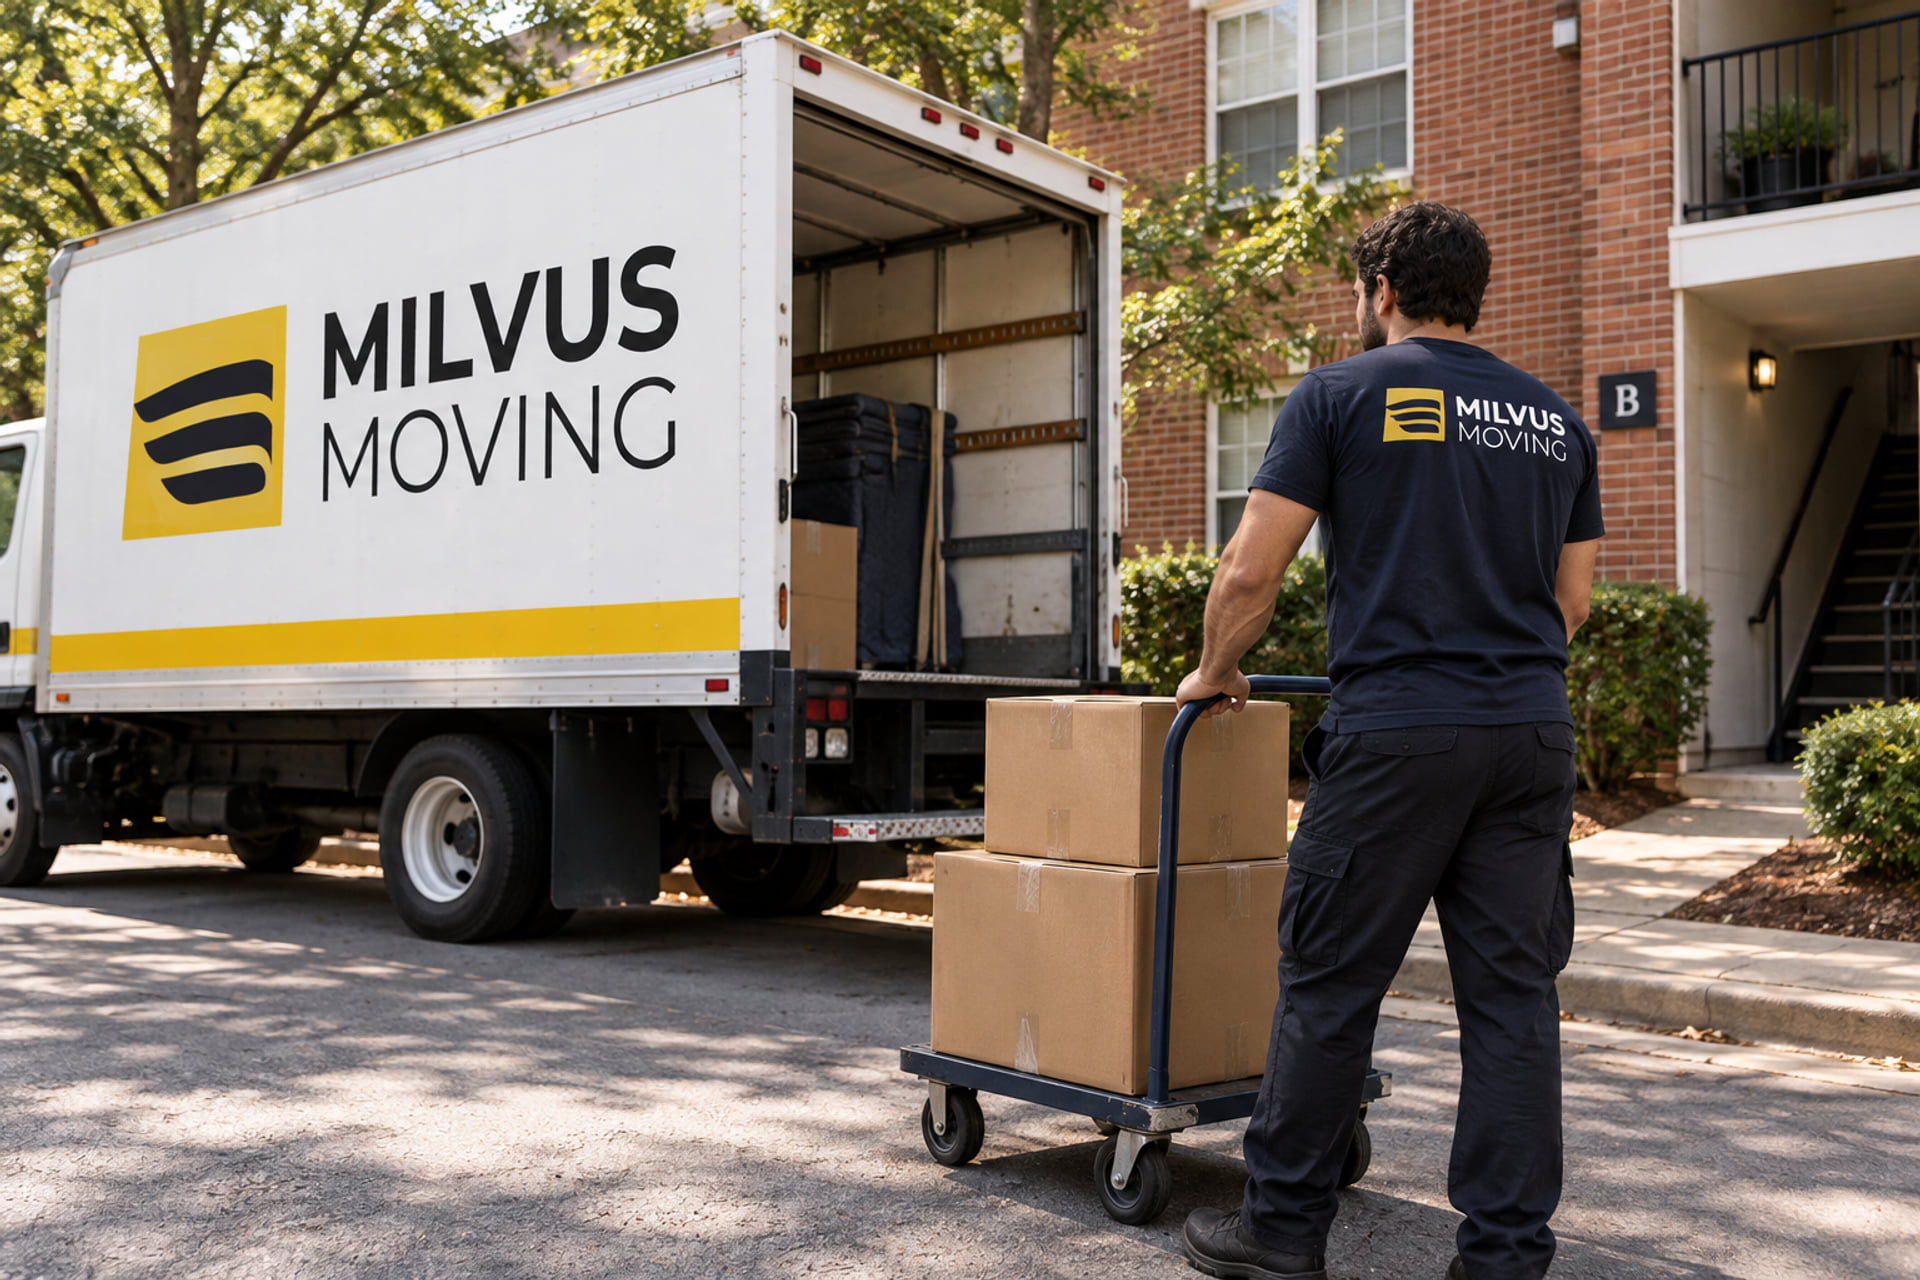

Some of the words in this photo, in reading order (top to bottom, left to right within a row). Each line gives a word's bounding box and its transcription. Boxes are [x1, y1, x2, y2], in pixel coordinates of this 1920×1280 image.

[323, 245, 679, 400] MILVUS
[1455, 396, 1566, 436] MILVUS
[1615, 384, 1640, 417] B
[322, 376, 677, 502] MOVING
[1458, 423, 1567, 462] MOVING
